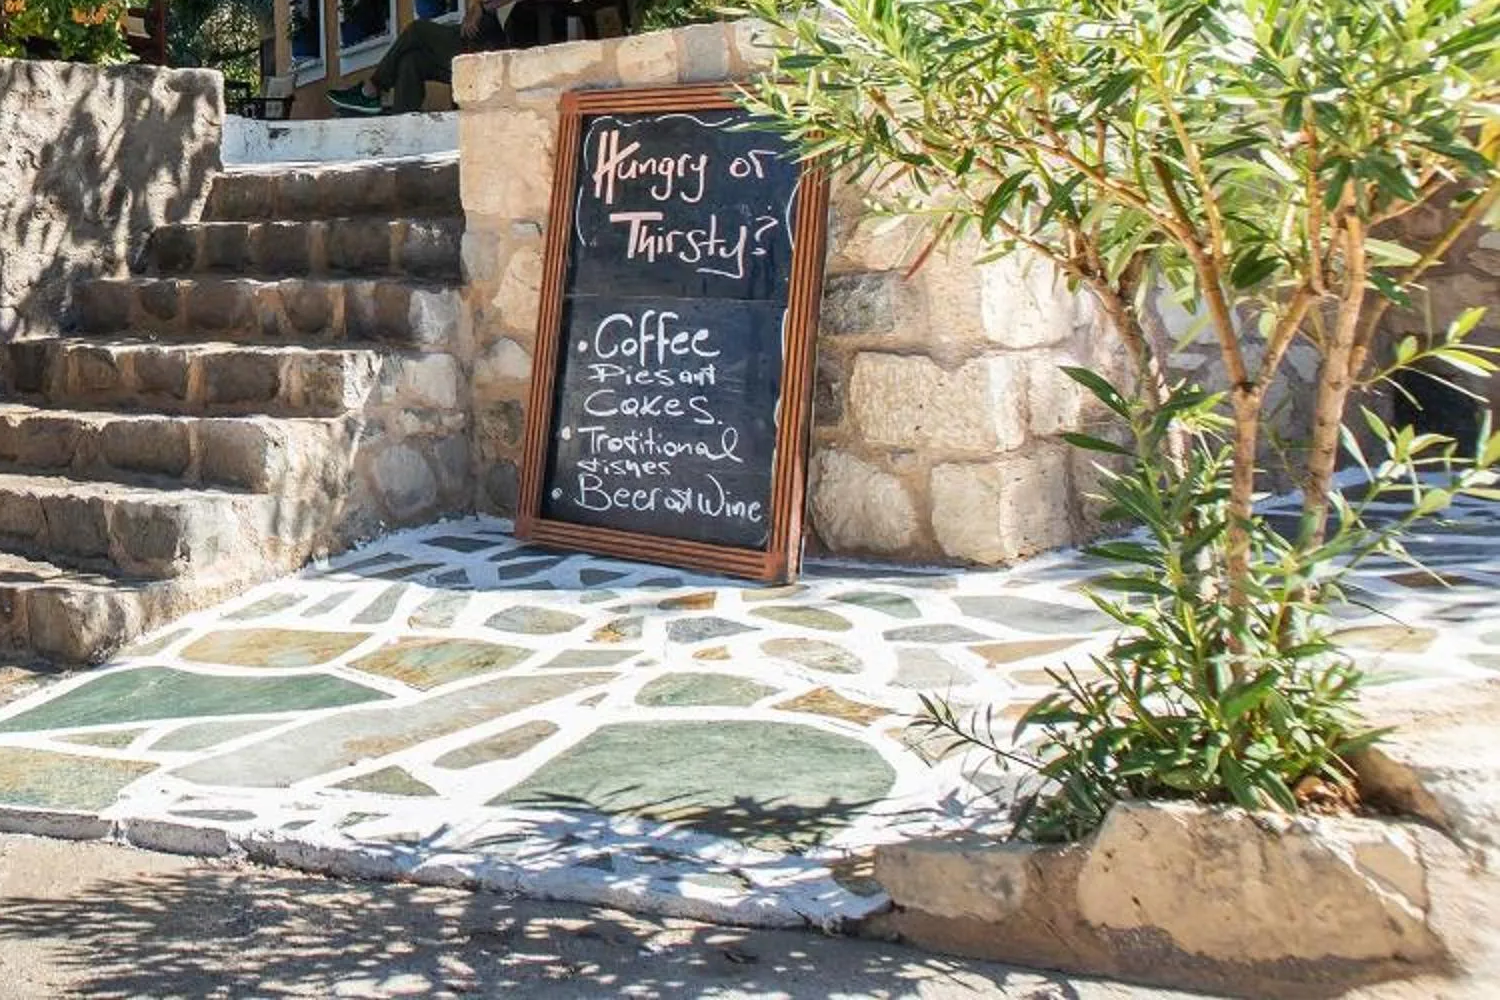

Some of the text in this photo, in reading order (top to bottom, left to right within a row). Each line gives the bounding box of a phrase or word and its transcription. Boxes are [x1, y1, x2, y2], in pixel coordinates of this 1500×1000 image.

[592, 129, 777, 205] Hungry or
[609, 211, 779, 279] Thirsty?
[595, 310, 721, 367] Coffee
[587, 362, 675, 386] Pies
[574, 473, 662, 512] Beer
[697, 473, 763, 523] Wine
